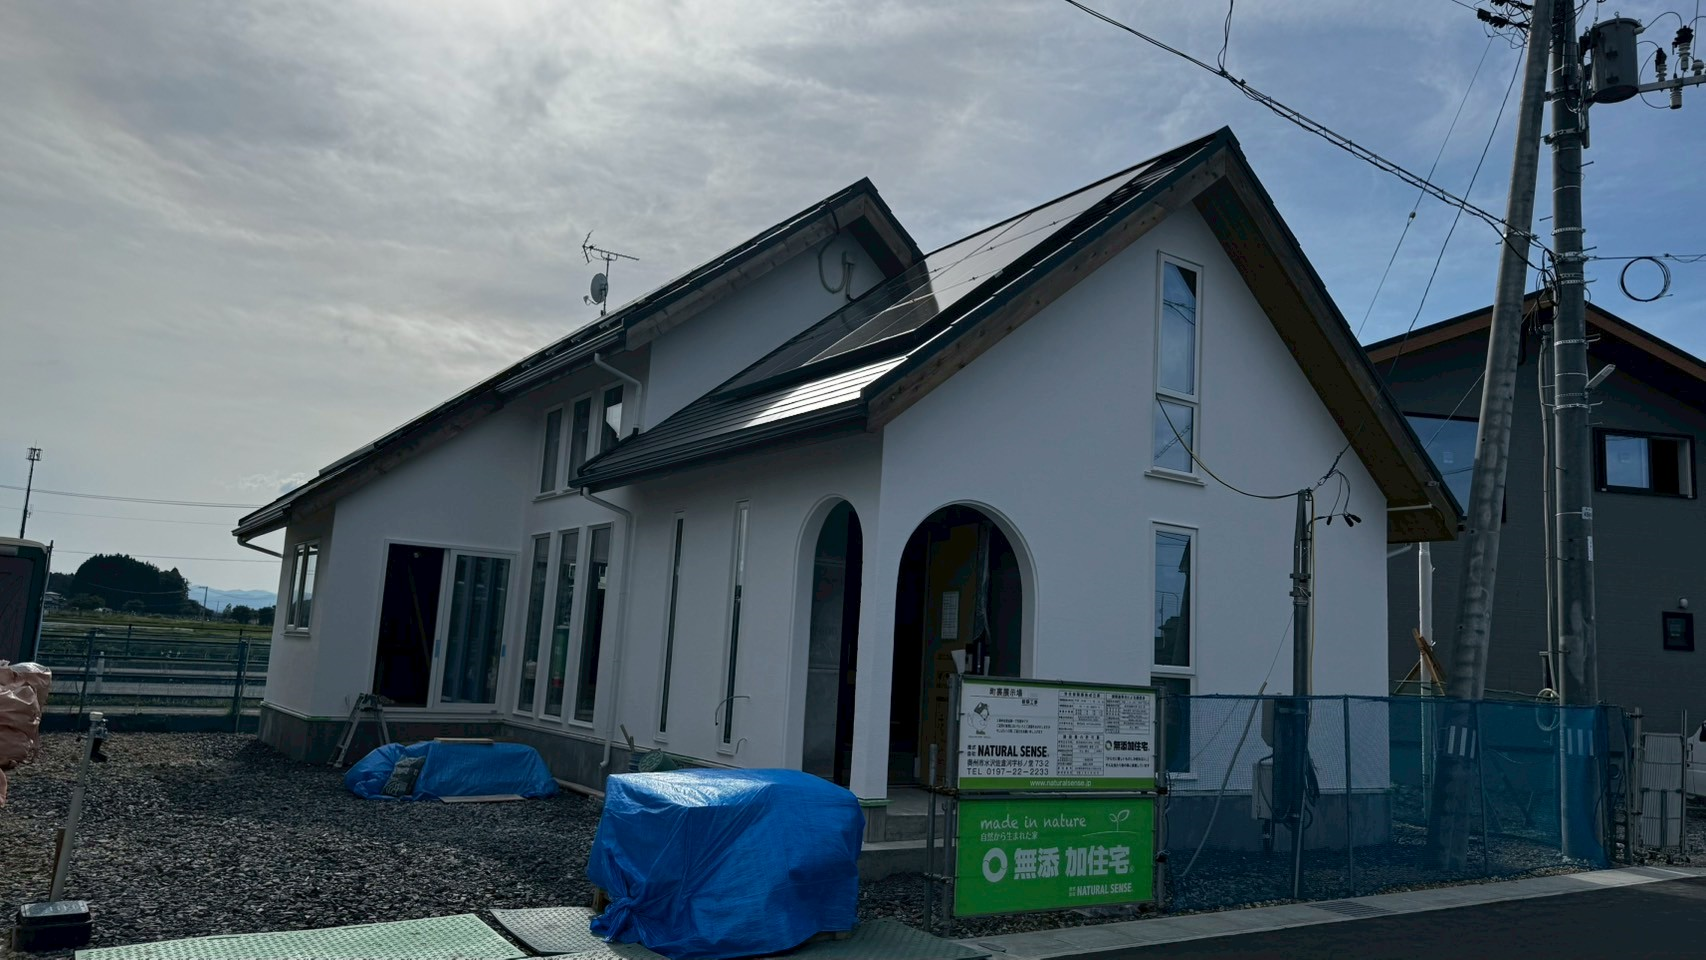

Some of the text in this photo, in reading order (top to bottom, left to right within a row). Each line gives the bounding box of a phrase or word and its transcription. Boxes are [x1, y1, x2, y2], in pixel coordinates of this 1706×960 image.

[978, 745, 1048, 758] NATURAL SENSE
[967, 768, 1049, 776] TEL 0197-22-2233
[980, 813, 1087, 830] made in nature
[980, 831, 1039, 842] 自然から生まれた家
[1077, 884, 1109, 897] NATURAL
[1110, 882, 1132, 893] SENSE
